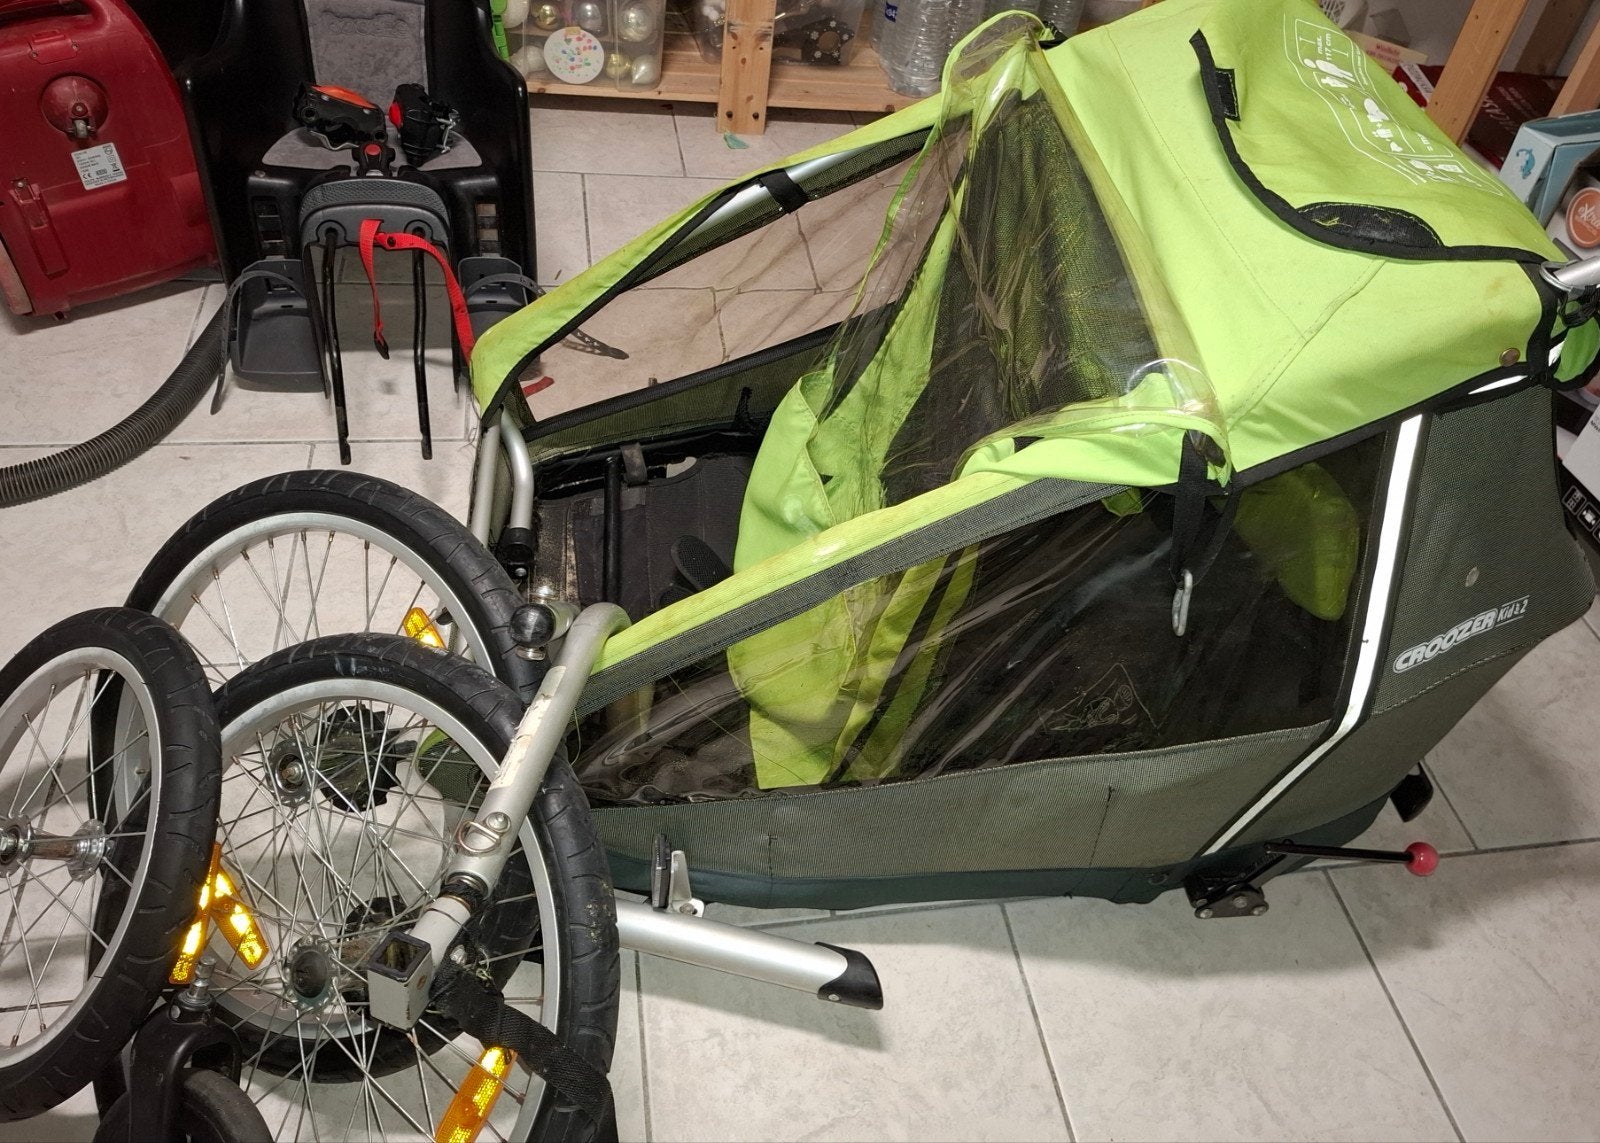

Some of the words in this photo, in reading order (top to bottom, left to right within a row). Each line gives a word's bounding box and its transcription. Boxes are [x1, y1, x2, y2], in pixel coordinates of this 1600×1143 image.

[1325, 33, 1331, 47] cm
[1394, 609, 1497, 672] CROOZER
[1497, 604, 1514, 622] Kid
[1520, 599, 1528, 613] 2
